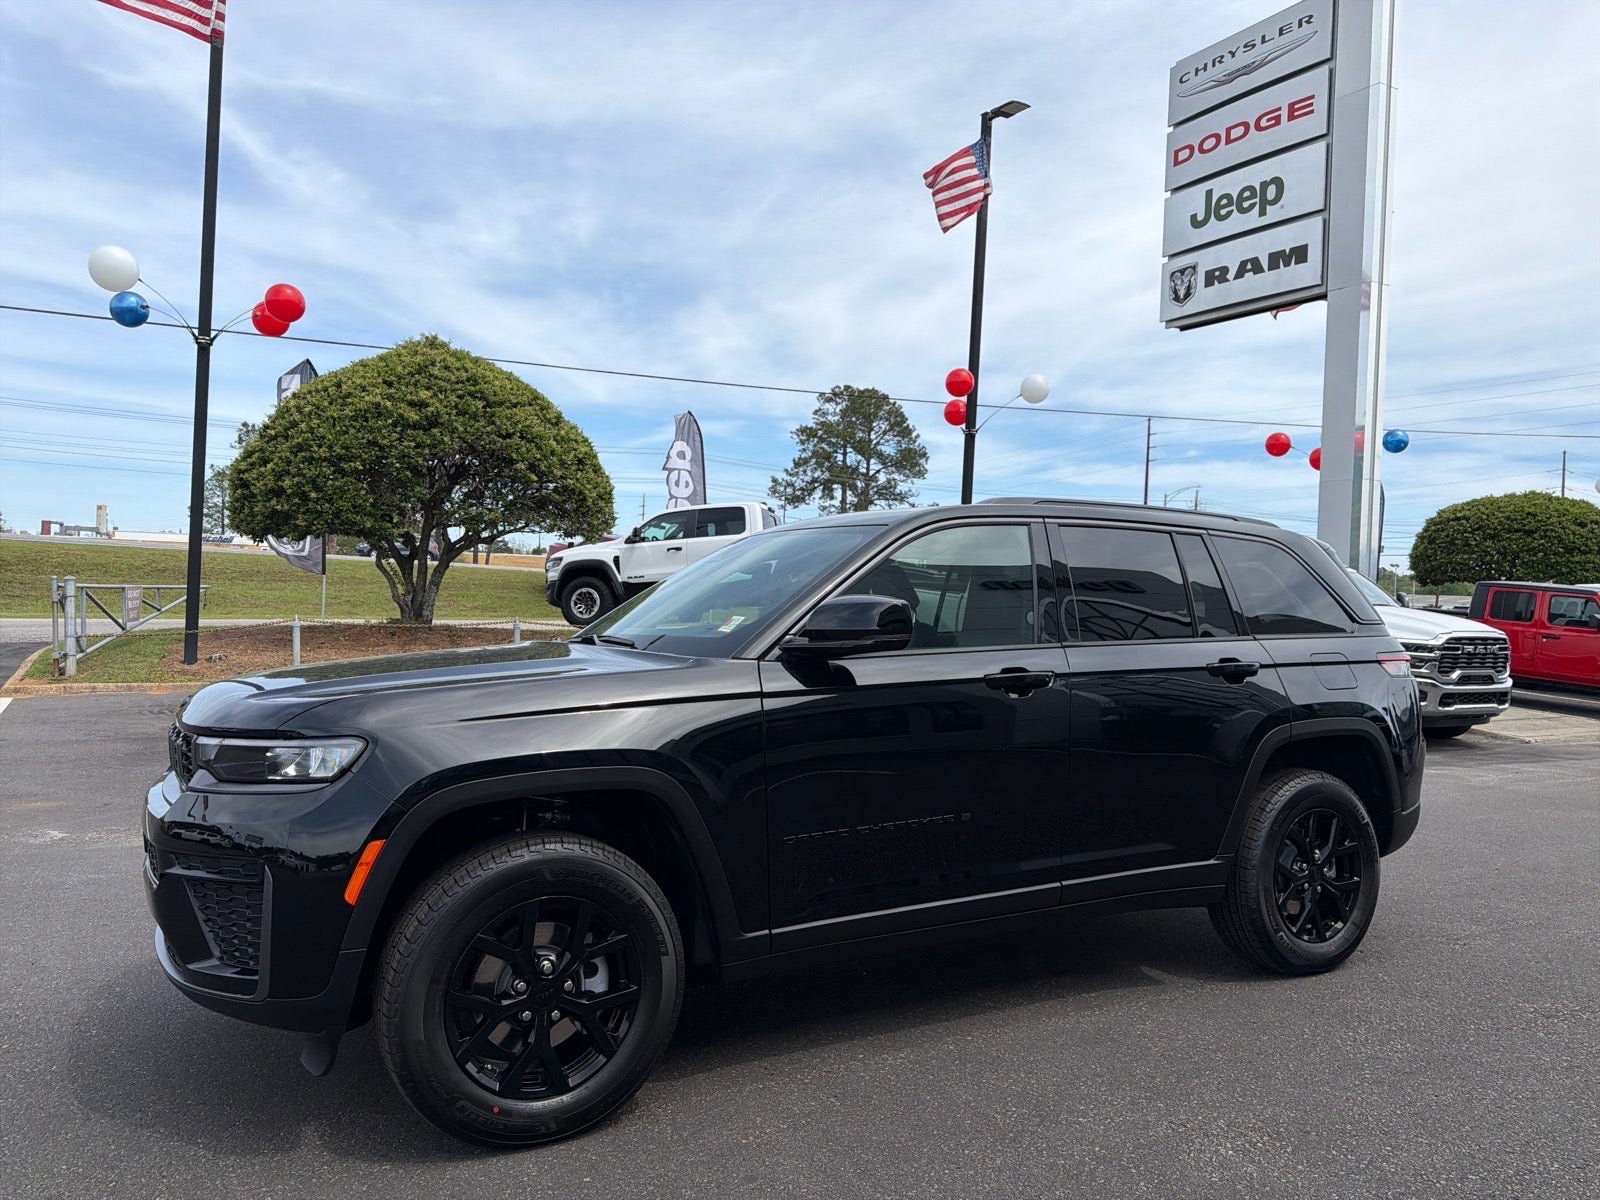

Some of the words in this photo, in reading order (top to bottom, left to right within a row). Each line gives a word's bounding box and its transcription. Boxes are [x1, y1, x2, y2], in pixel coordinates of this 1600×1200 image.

[1178, 13, 1315, 85] CHRYSLER
[1172, 93, 1316, 168] DODGE
[1189, 175, 1285, 230] Jeep
[1203, 243, 1309, 289] RAM
